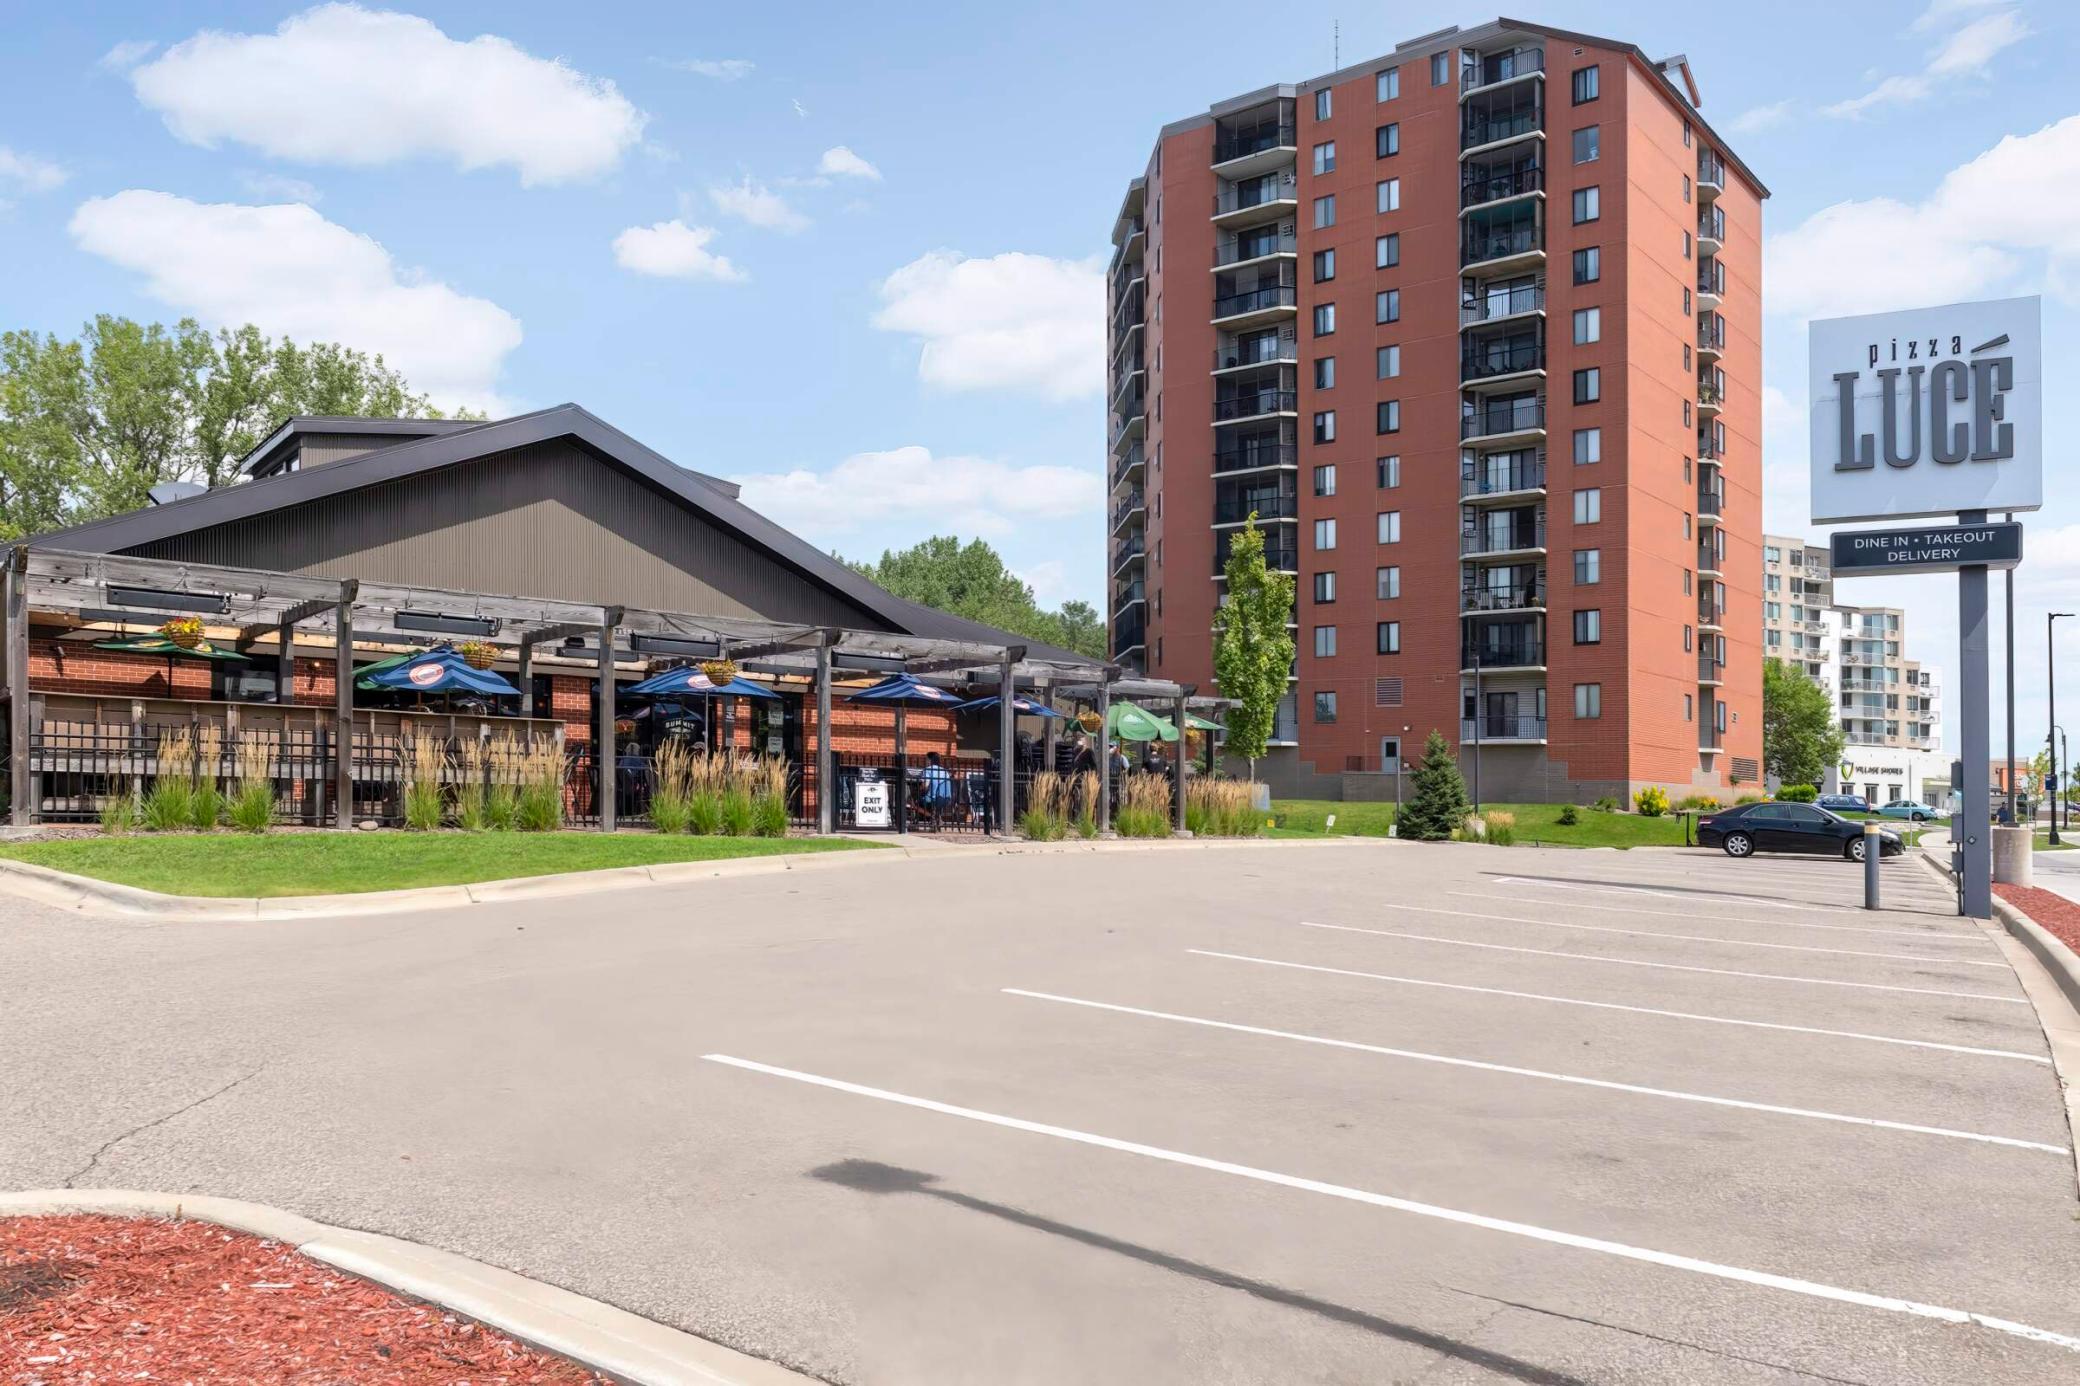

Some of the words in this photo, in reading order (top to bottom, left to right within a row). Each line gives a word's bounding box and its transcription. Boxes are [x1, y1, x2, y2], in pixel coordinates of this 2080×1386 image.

[1869, 335, 1962, 368] pizza
[1833, 333, 2013, 472] LUCÉ
[1854, 537, 1889, 549] DINE
[1894, 536, 1909, 547] IN
[1924, 531, 1996, 545] TAKEOUT
[1887, 548, 1960, 562] DELIVERY
[1855, 766, 1880, 775] VILLAGE
[861, 806, 883, 814] ONLY
